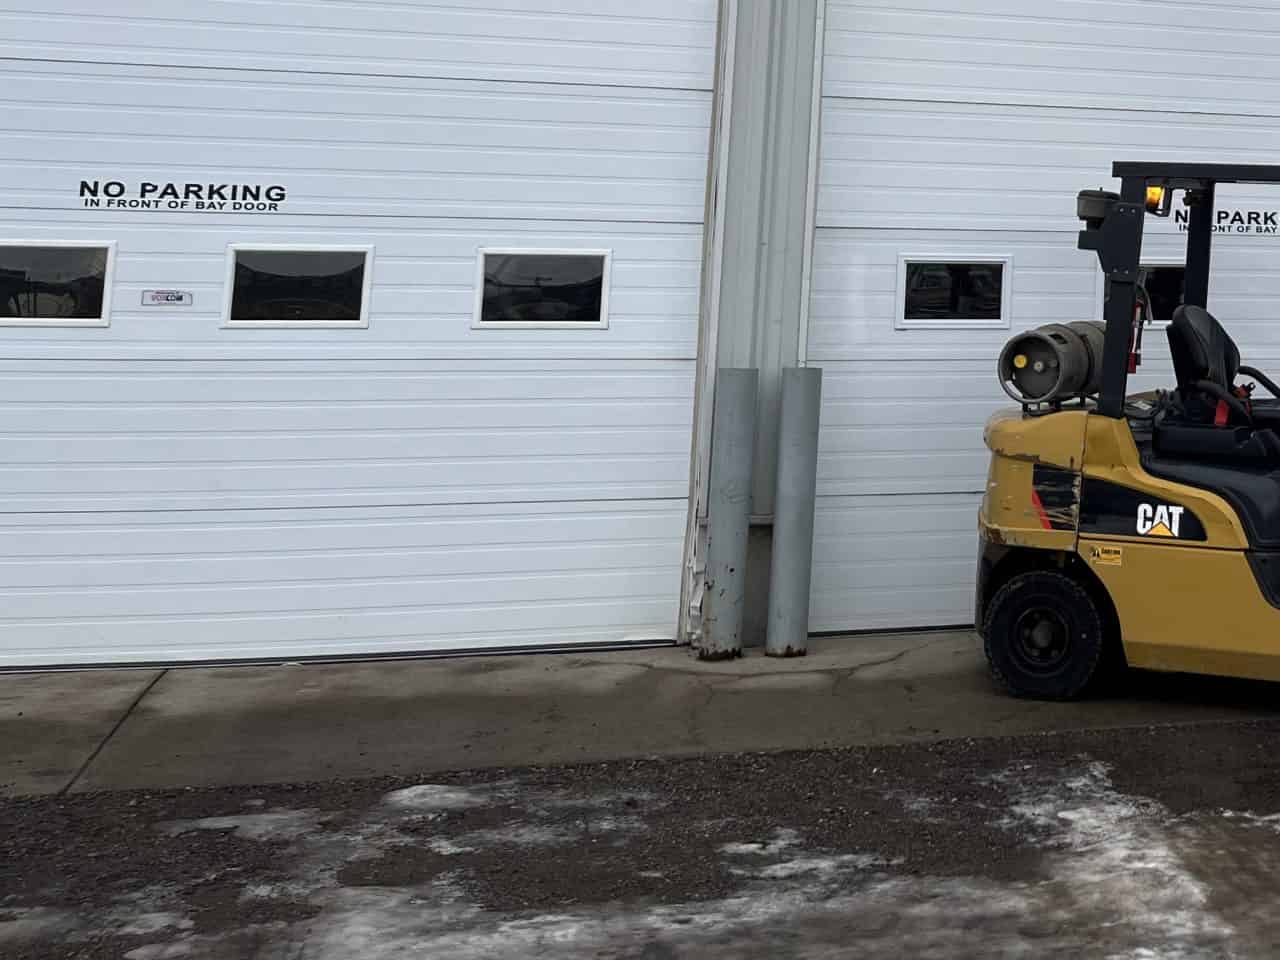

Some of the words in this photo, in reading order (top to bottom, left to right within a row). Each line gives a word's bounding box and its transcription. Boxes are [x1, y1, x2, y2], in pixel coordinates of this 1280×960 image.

[80, 181, 125, 198] NO
[140, 182, 286, 202] PARKING
[84, 198, 100, 207] IN
[107, 199, 162, 209] FRONT
[168, 200, 190, 209] OF
[195, 201, 227, 210] BAY
[232, 202, 279, 211] DOOR
[1175, 209, 1189, 223] N
[1237, 225, 1252, 233] OF
[1256, 226, 1278, 234] BAY
[1136, 503, 1184, 537] CAT
